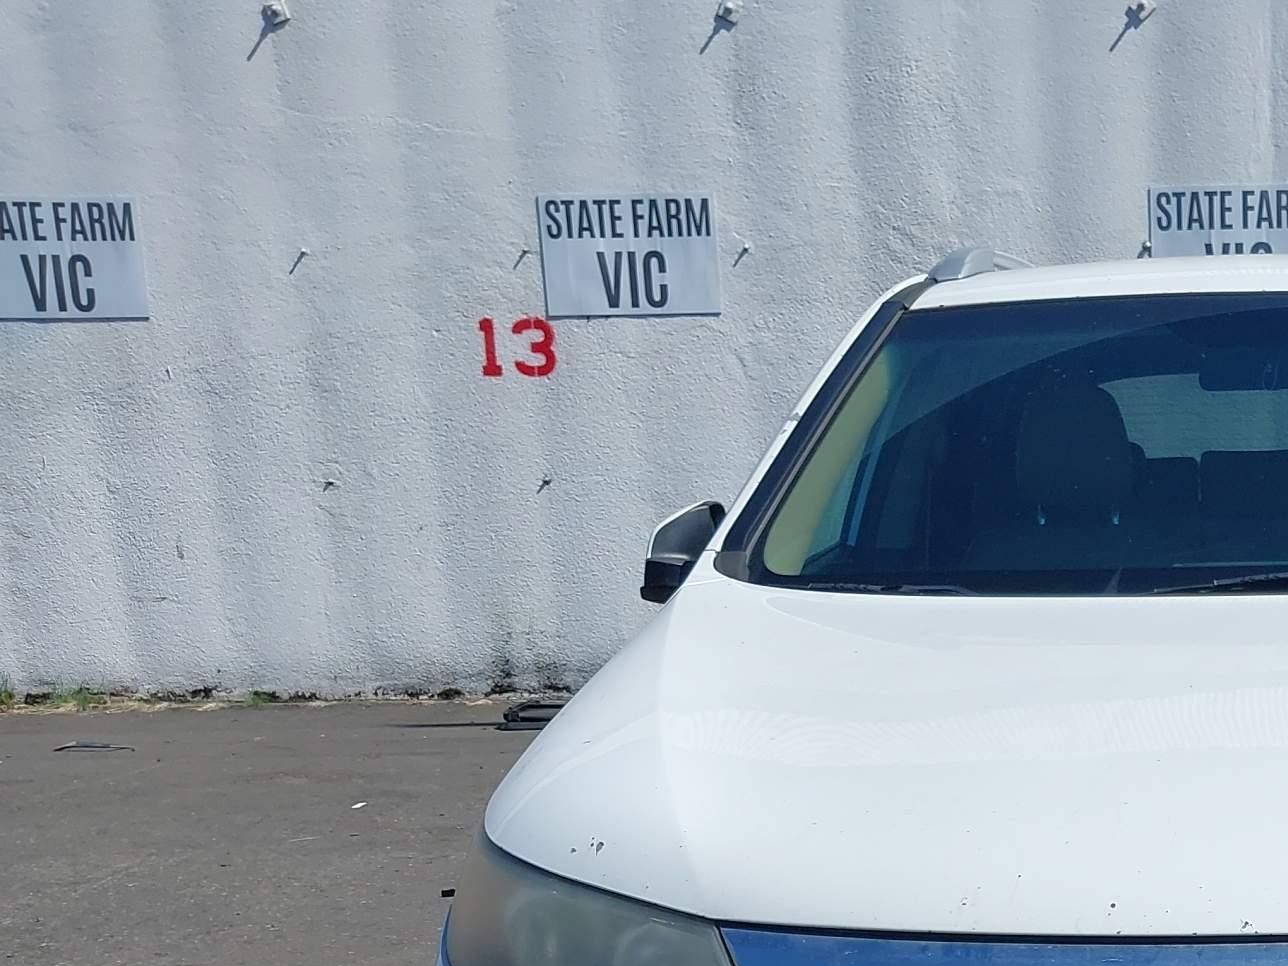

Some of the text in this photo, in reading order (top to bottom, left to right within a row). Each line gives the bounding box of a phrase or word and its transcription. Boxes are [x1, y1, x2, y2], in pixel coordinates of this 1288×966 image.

[51, 202, 136, 242] FARM
[544, 197, 712, 240] STATE FARM
[1155, 190, 1235, 231] STATE
[20, 253, 97, 313] VIC
[596, 250, 669, 309] VIC
[478, 316, 557, 378] 13
